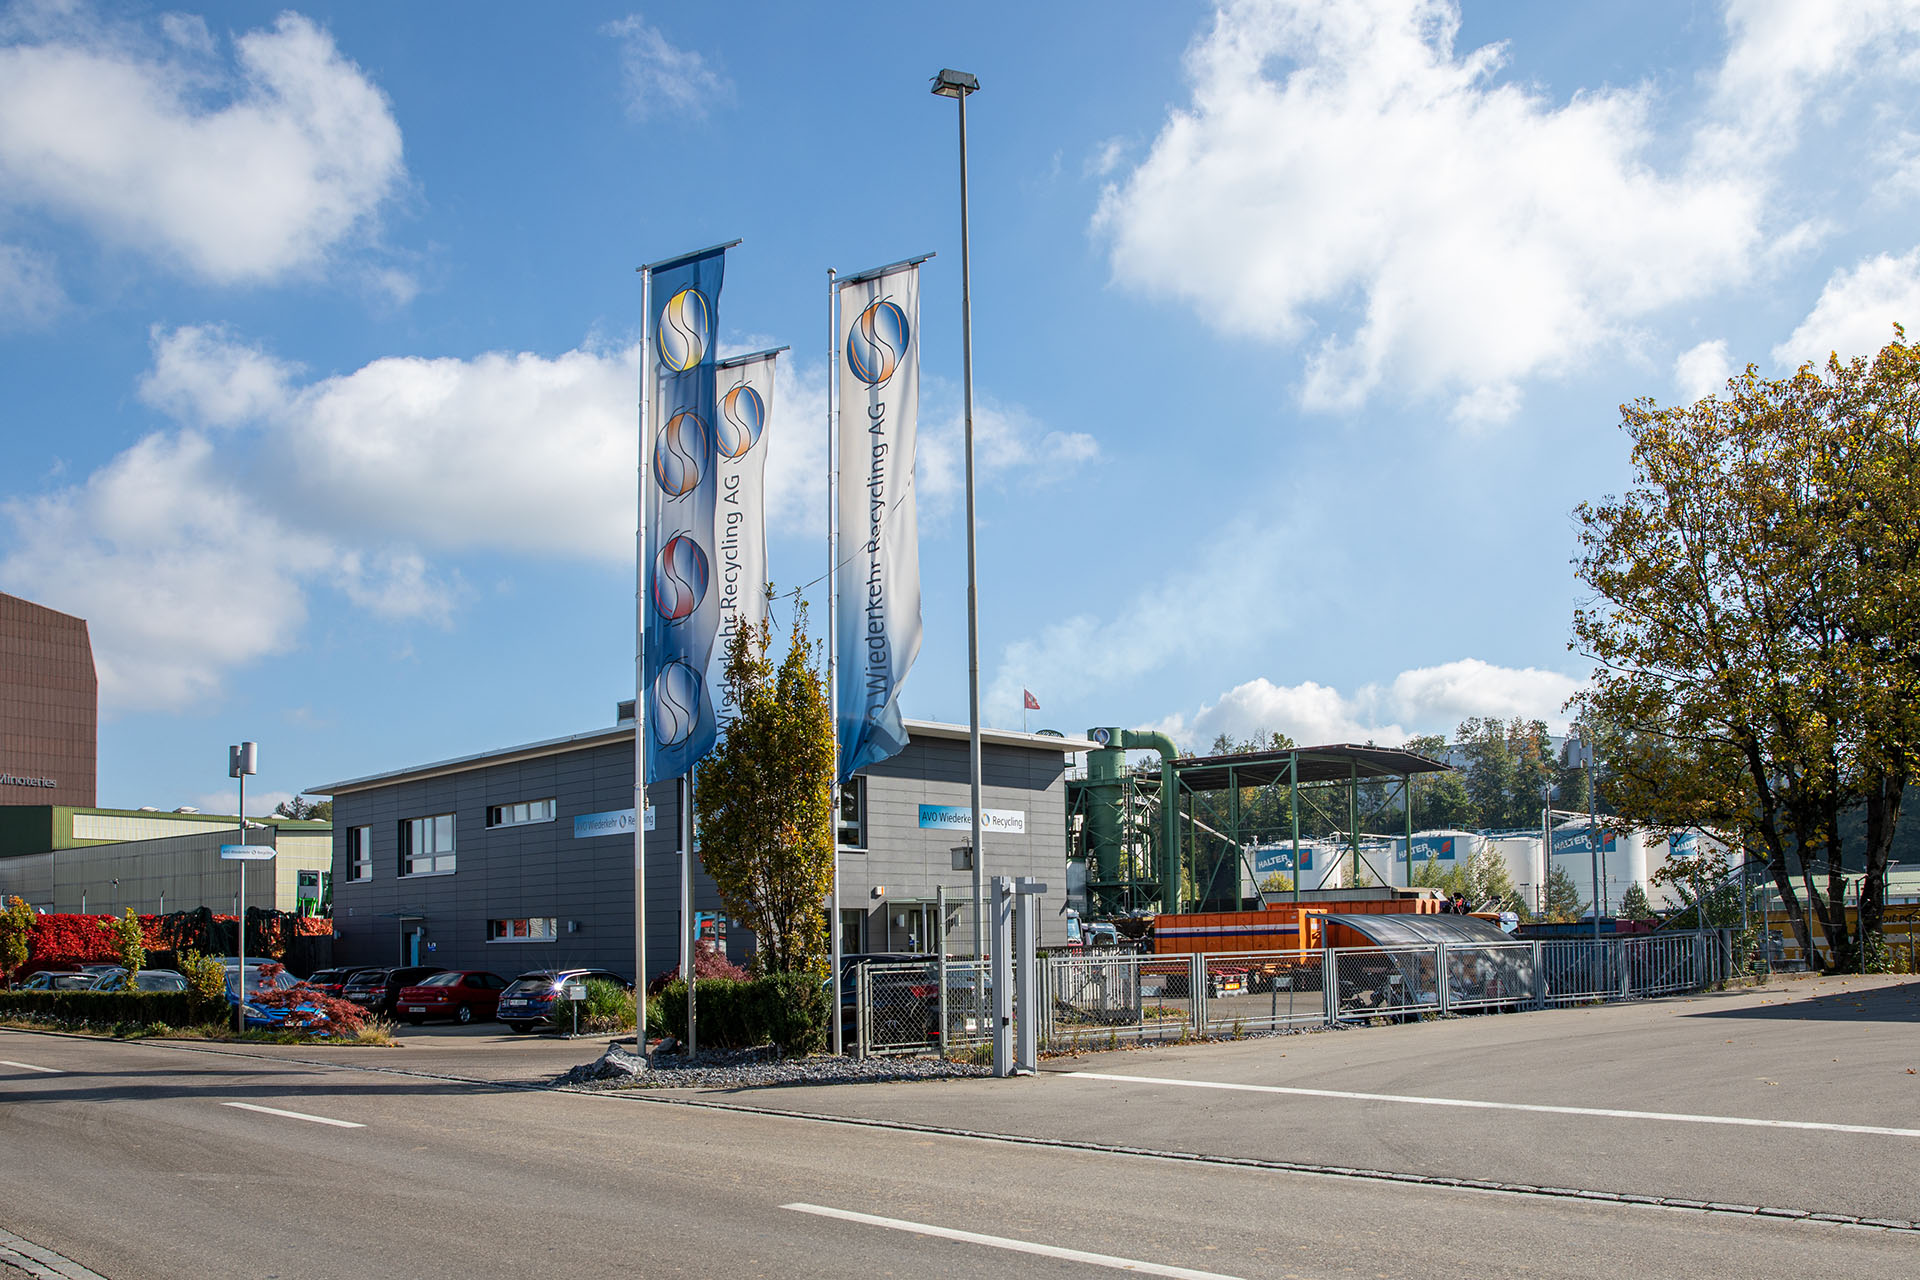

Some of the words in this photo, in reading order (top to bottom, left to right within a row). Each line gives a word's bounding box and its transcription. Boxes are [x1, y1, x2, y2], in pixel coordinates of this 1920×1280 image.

[867, 401, 886, 436] AG
[723, 474, 740, 505] AG
[865, 442, 889, 554] Recycling
[720, 511, 744, 609] Recycling
[865, 560, 888, 698] Wiederkehr
[588, 817, 618, 831] Wiederkehr
[627, 815, 654, 827] Reing
[922, 811, 938, 823] AVO
[939, 812, 972, 825] Wiederke
[992, 815, 1023, 830] Recycling
[1398, 843, 1429, 859] HATER
[1553, 834, 1589, 852] HALTER
[1257, 854, 1289, 870] HALTER
